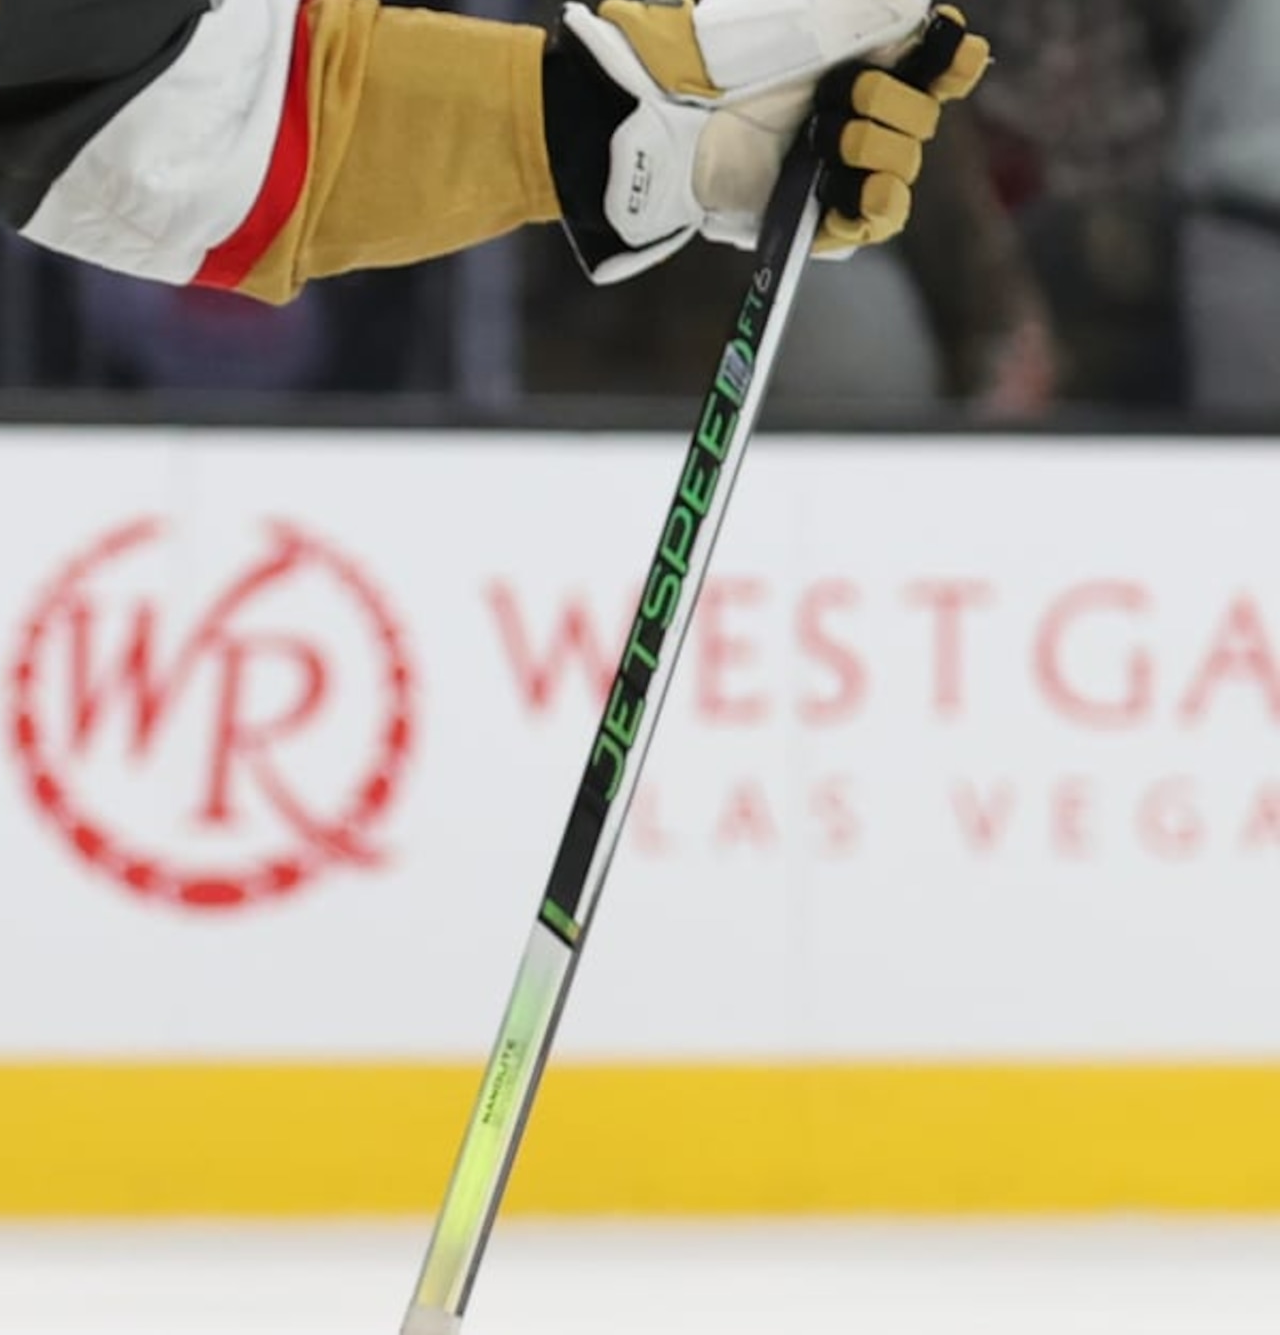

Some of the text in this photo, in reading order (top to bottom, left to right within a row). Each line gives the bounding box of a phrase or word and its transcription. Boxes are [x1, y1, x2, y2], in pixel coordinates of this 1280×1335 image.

[626, 150, 646, 216] CCM
[737, 267, 772, 337] FT6
[630, 774, 862, 858] LAS
